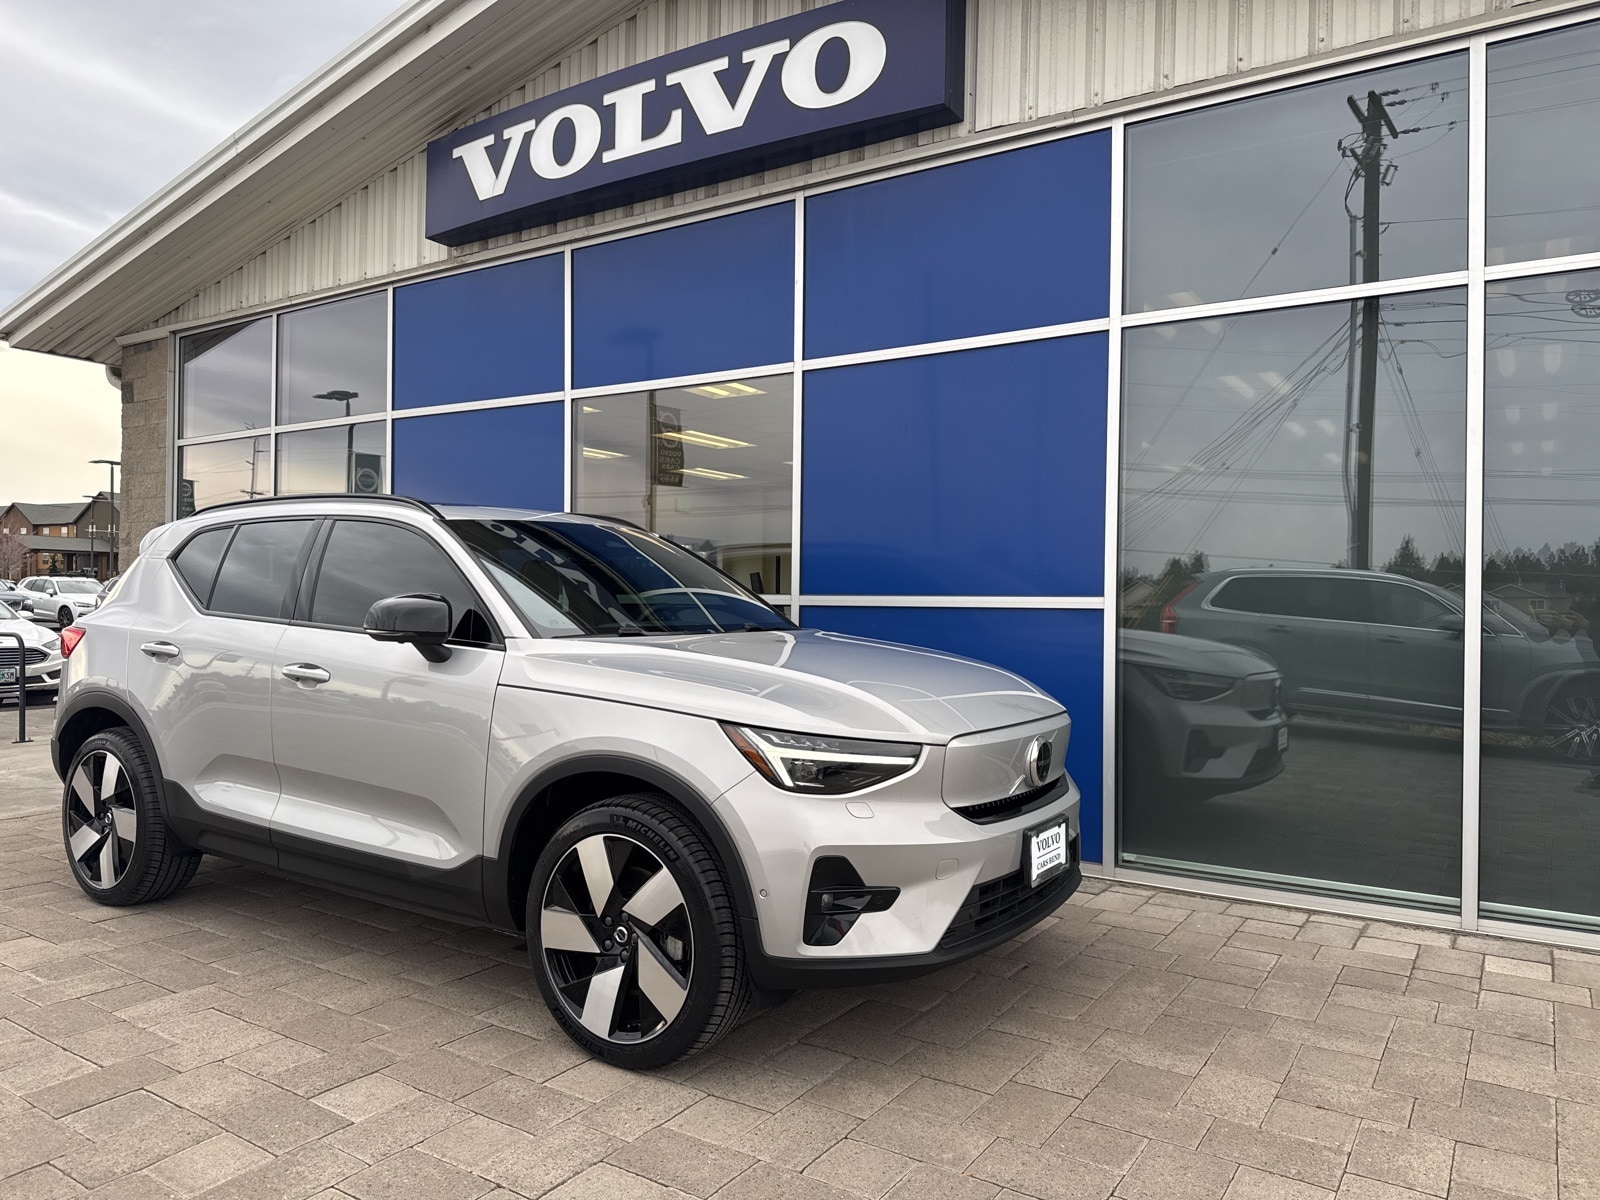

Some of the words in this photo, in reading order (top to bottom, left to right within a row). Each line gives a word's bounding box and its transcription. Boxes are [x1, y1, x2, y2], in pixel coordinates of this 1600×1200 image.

[452, 20, 887, 201] VOLVO
[625, 819, 679, 861] MICHELIN
[1036, 832, 1061, 852] VOLVO
[1037, 858, 1048, 870] CARS
